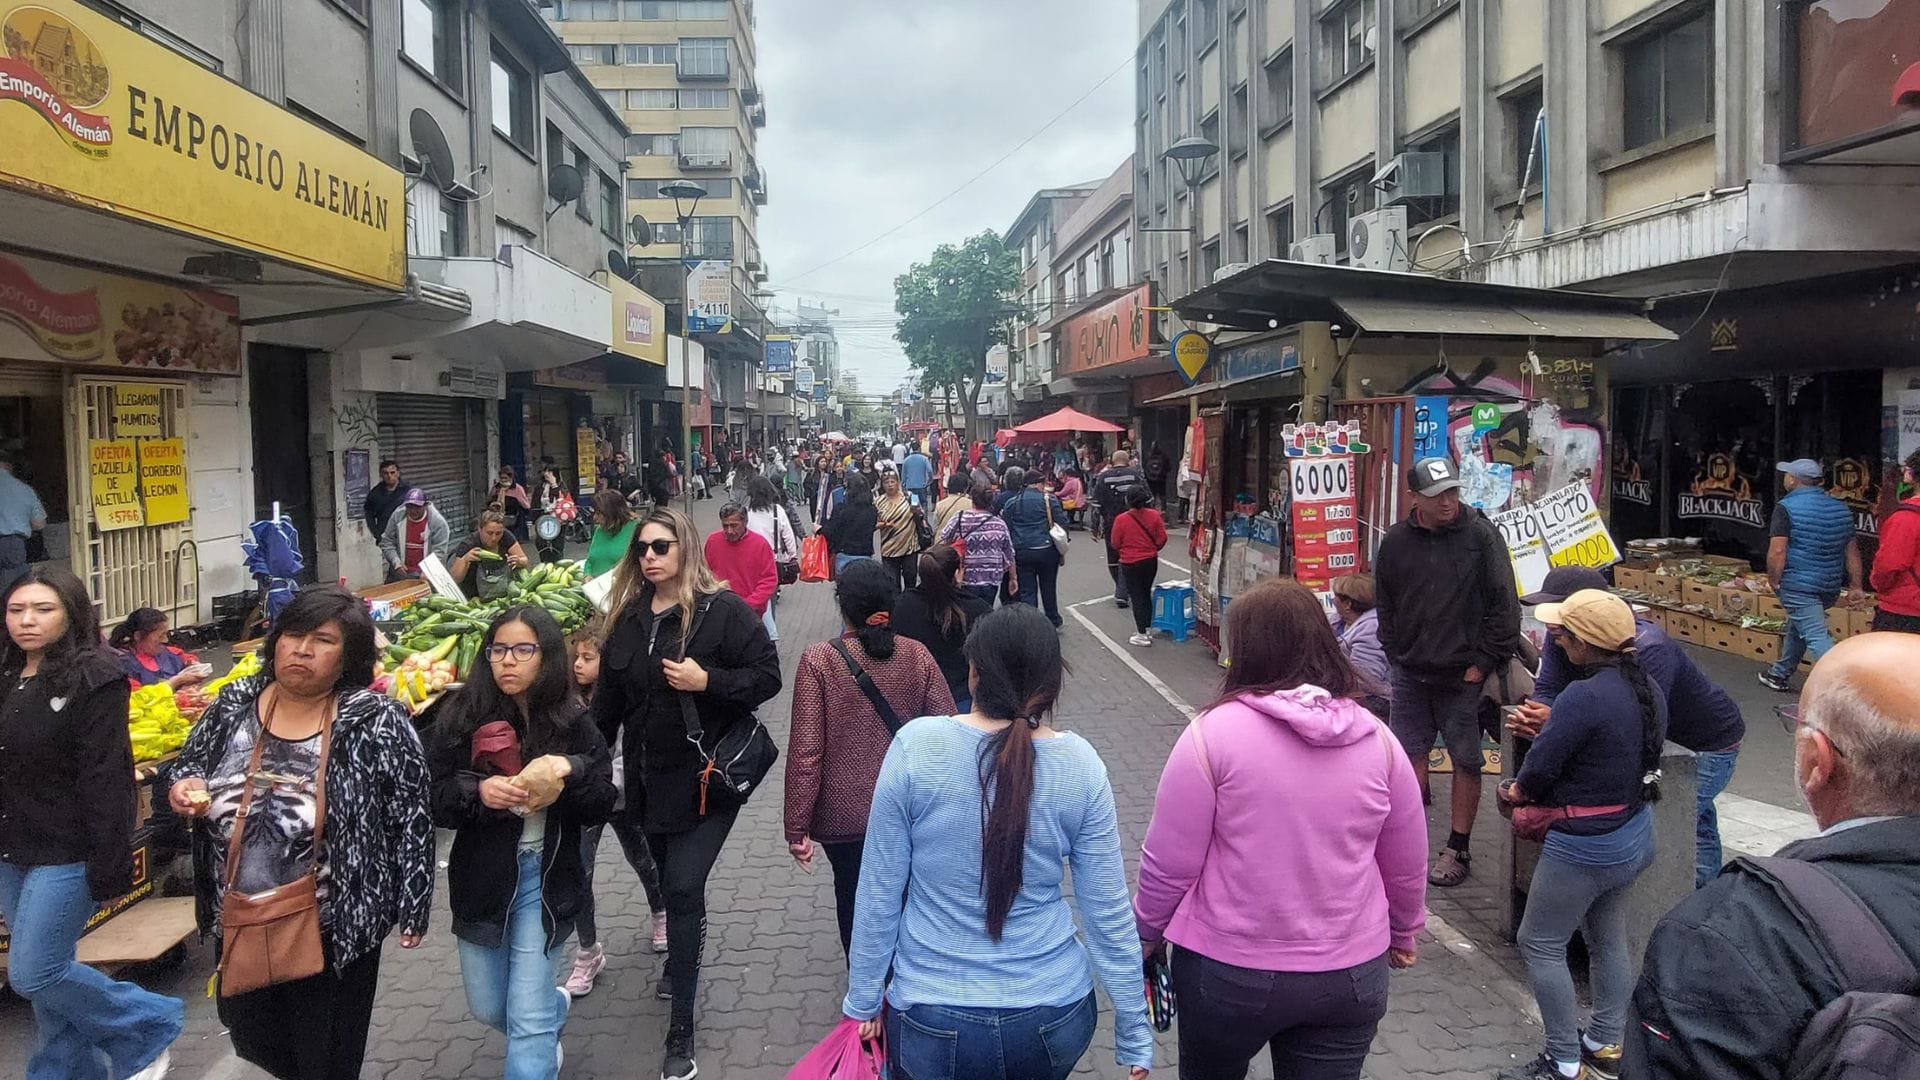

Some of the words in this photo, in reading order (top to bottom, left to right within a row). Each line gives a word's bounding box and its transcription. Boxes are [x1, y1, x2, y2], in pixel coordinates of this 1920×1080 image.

[0, 72, 61, 115] Emporio
[62, 112, 111, 142] Alemán
[127, 85, 284, 191] EMPORIO
[295, 161, 388, 231] ALEMÁN
[116, 392, 158, 406] LLEGARON
[121, 414, 156, 425] HUMITAS
[1414, 421, 1438, 434] HIP
[94, 446, 131, 459] OFERTA
[143, 446, 178, 458] OFERTA
[92, 462, 133, 475] CAZUELA
[142, 464, 182, 477] CORDERO
[1712, 463, 1727, 479] VIP
[107, 477, 118, 490] DE
[1295, 462, 1348, 495] 6000
[1840, 470, 1858, 490] VIP
[144, 483, 178, 498] LECHON
[1611, 480, 1649, 501] KJACK
[95, 491, 137, 507] ALETILLA
[1540, 493, 1588, 529] LOTO
[1681, 496, 1762, 524] BLACKJACK
[1498, 514, 1536, 542] OTO
[1329, 555, 1354, 567] 1000
